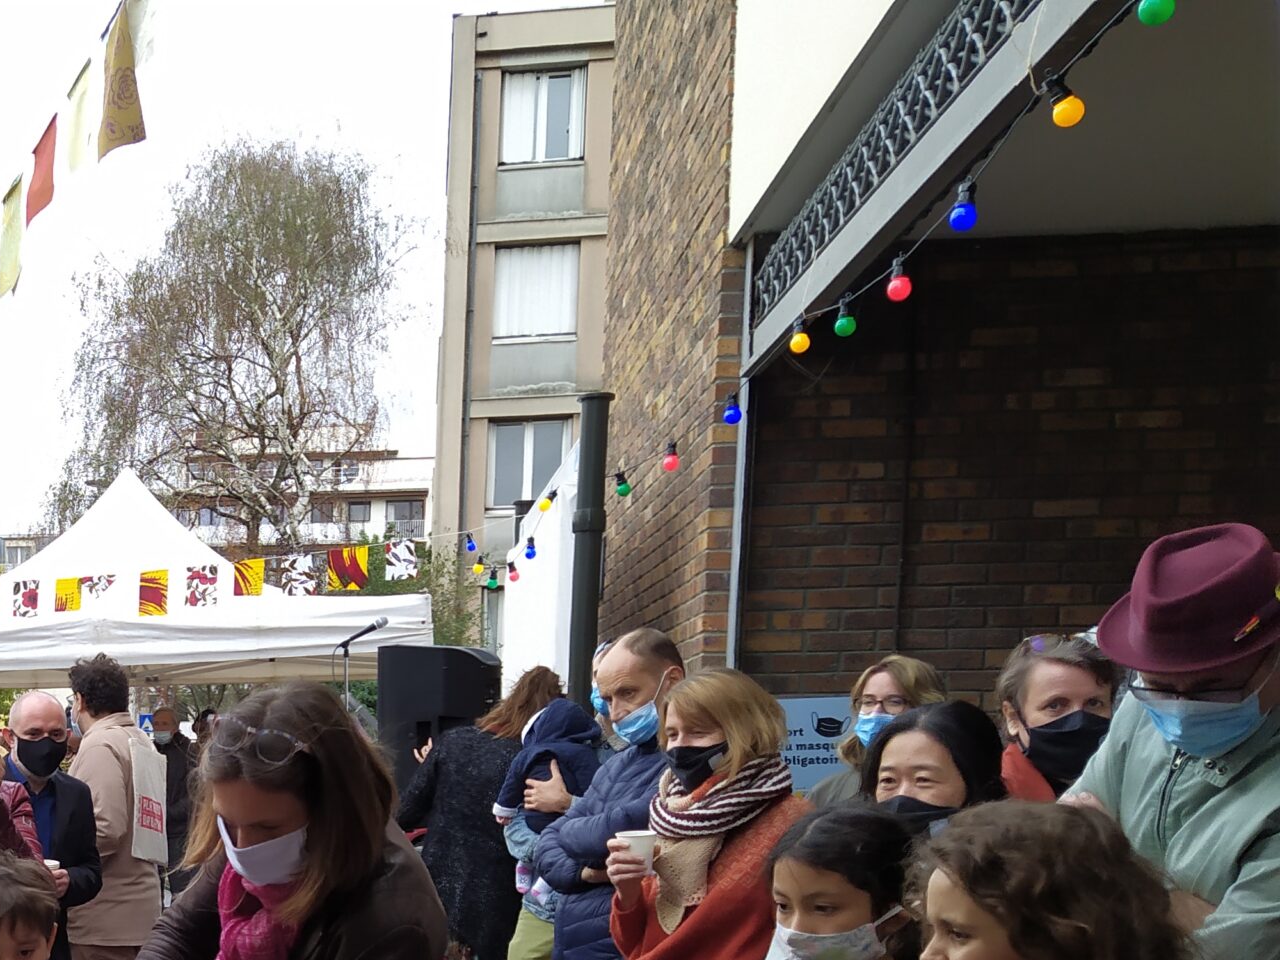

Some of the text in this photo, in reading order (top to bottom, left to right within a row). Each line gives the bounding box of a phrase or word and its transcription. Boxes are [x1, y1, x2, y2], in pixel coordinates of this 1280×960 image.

[787, 727, 804, 737] ort
[796, 742, 837, 752] masqu
[781, 754, 839, 767] bligatoir
